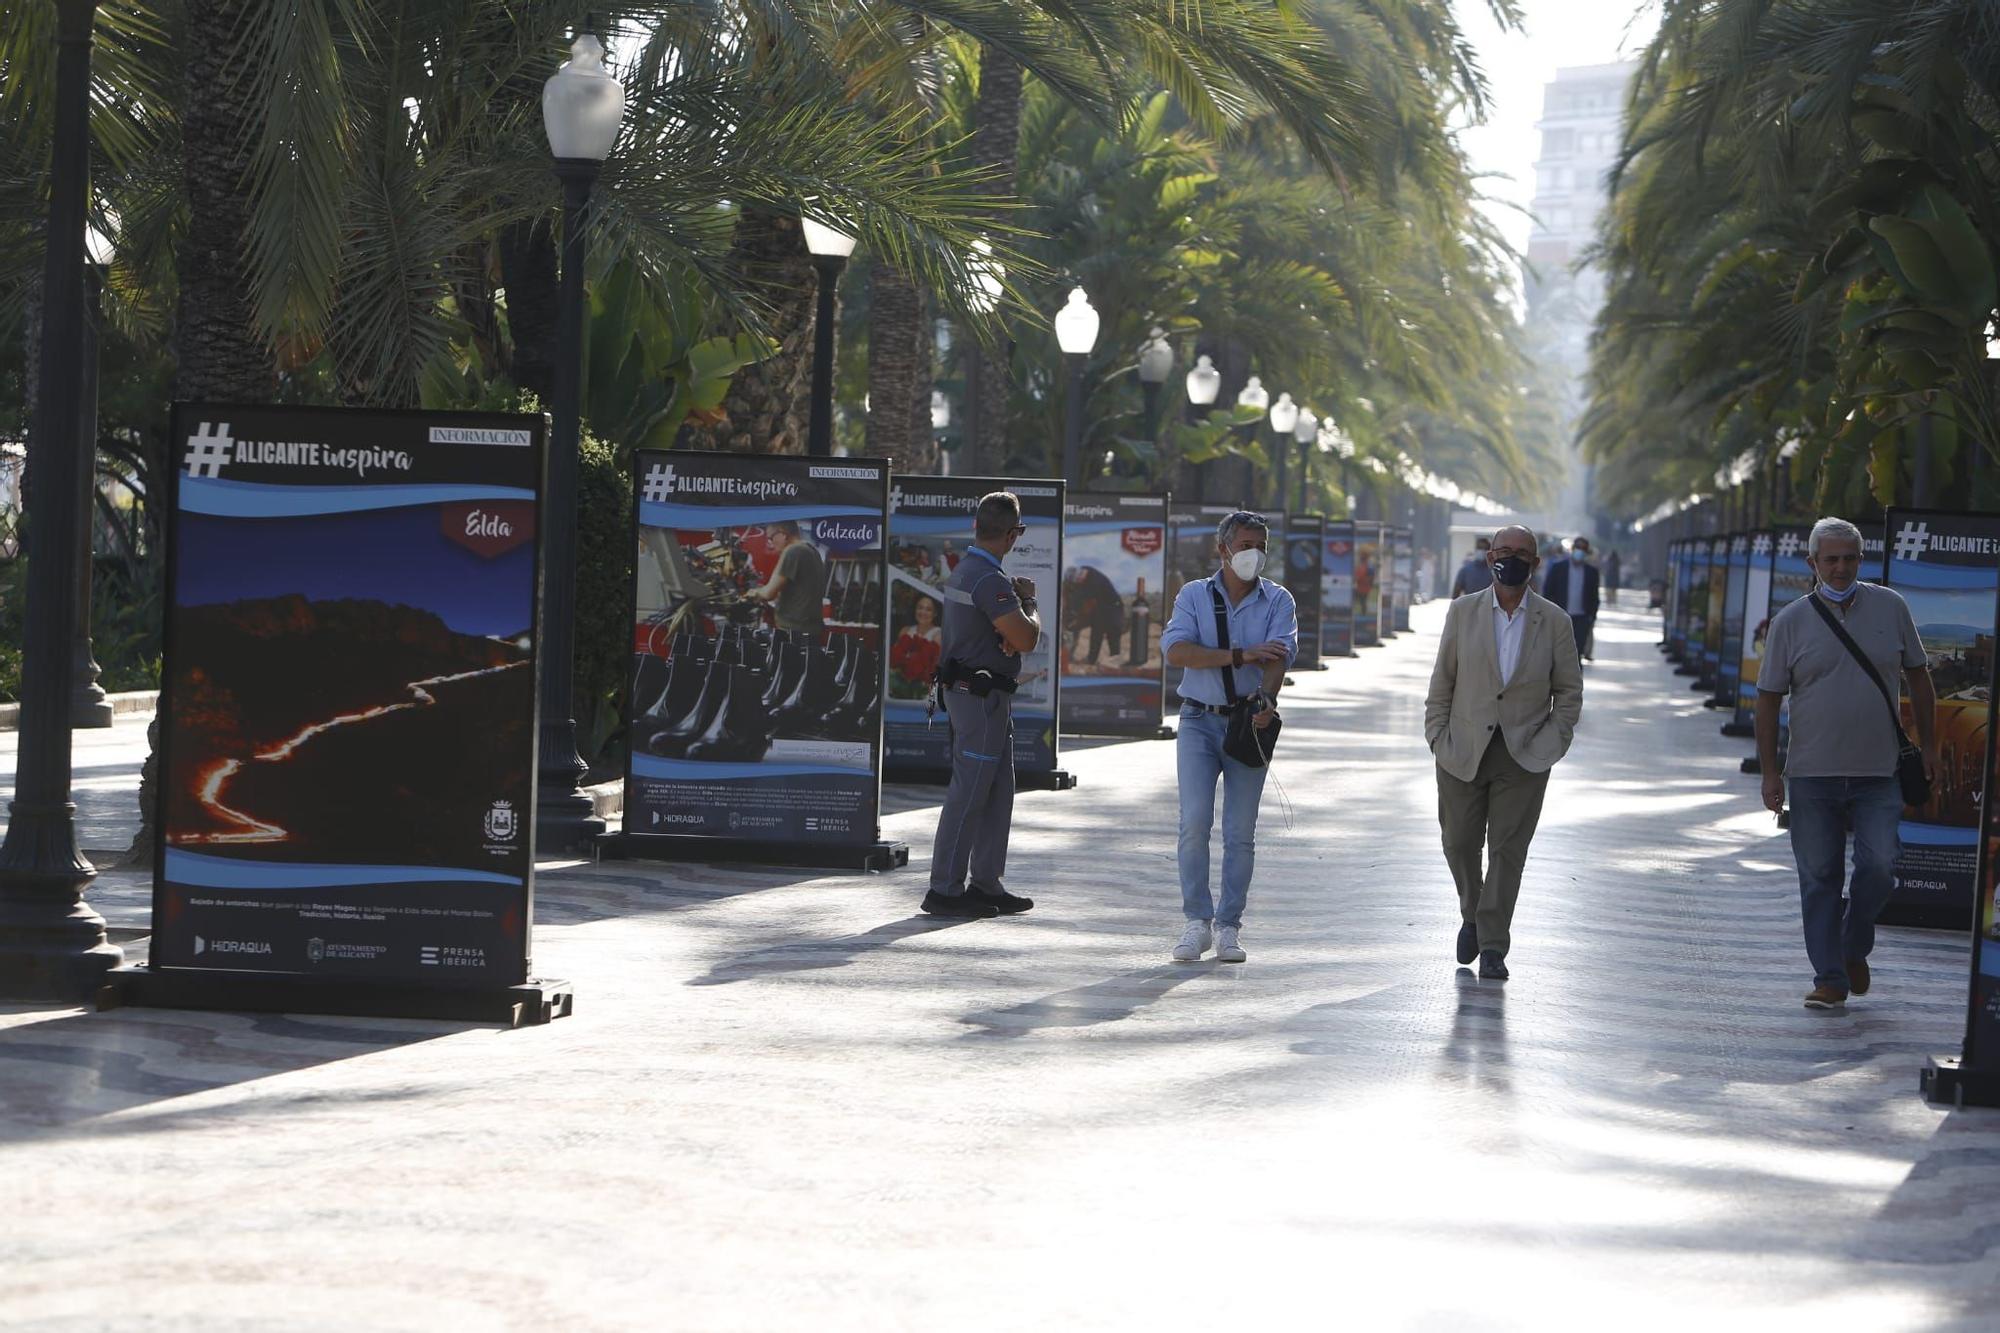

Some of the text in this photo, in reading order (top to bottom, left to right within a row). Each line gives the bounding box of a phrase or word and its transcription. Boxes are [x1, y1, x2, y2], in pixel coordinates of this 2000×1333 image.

[322, 443, 413, 477] inspira
[736, 479, 799, 500] inspira
[816, 520, 873, 541] Calzado
[443, 947, 485, 957] PRENSA
